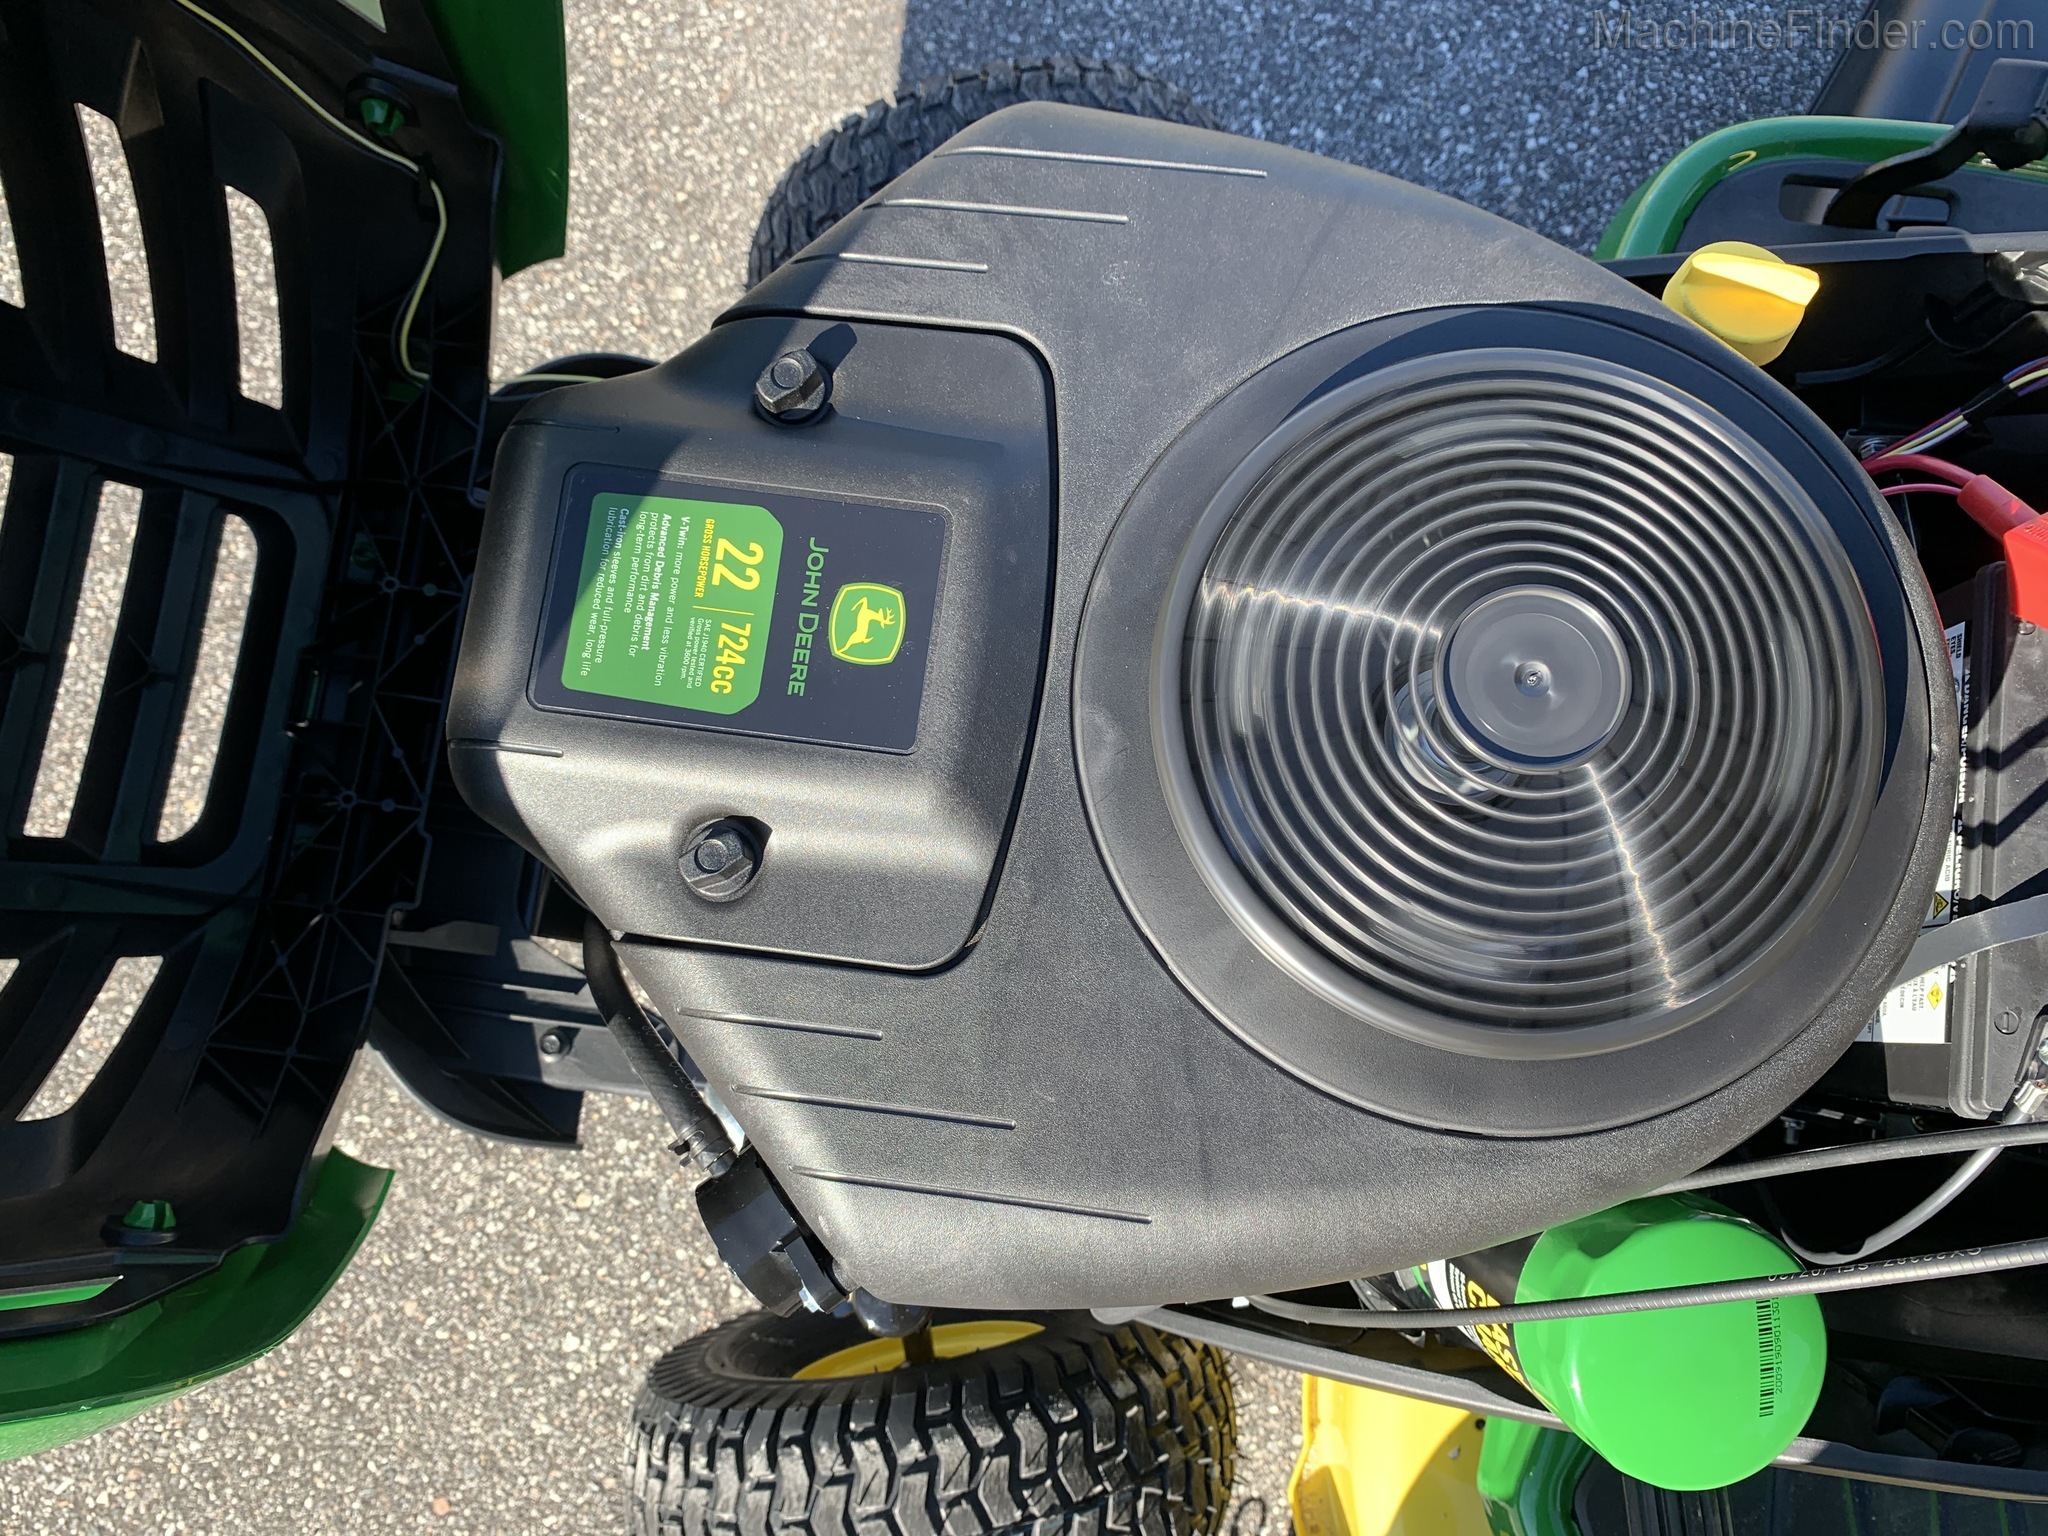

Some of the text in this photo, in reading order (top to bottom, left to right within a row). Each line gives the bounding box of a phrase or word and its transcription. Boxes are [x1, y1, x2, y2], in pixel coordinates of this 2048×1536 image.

[580, 506, 617, 676] lubrication for reduced wear, long life
[593, 508, 629, 663] Cast-iron sleeves and full-pressure
[622, 510, 648, 613] long-term performance
[627, 511, 659, 657] protects from dirt and debris for
[639, 513, 671, 650] Advanced Debris Management
[694, 517, 714, 598] GROSS HORSEPOWER
[710, 537, 765, 592] 22
[653, 516, 690, 686] V-Twin: more power and less vibration
[686, 616, 696, 639] verified
[786, 536, 830, 697] JOHN DEERE
[678, 665, 687, 680] rpm.
[682, 647, 691, 665] 3600
[686, 617, 703, 688] Gross power tested and
[694, 618, 711, 687] SAE J1940 CERTIFIED
[709, 619, 751, 696] 724cc
